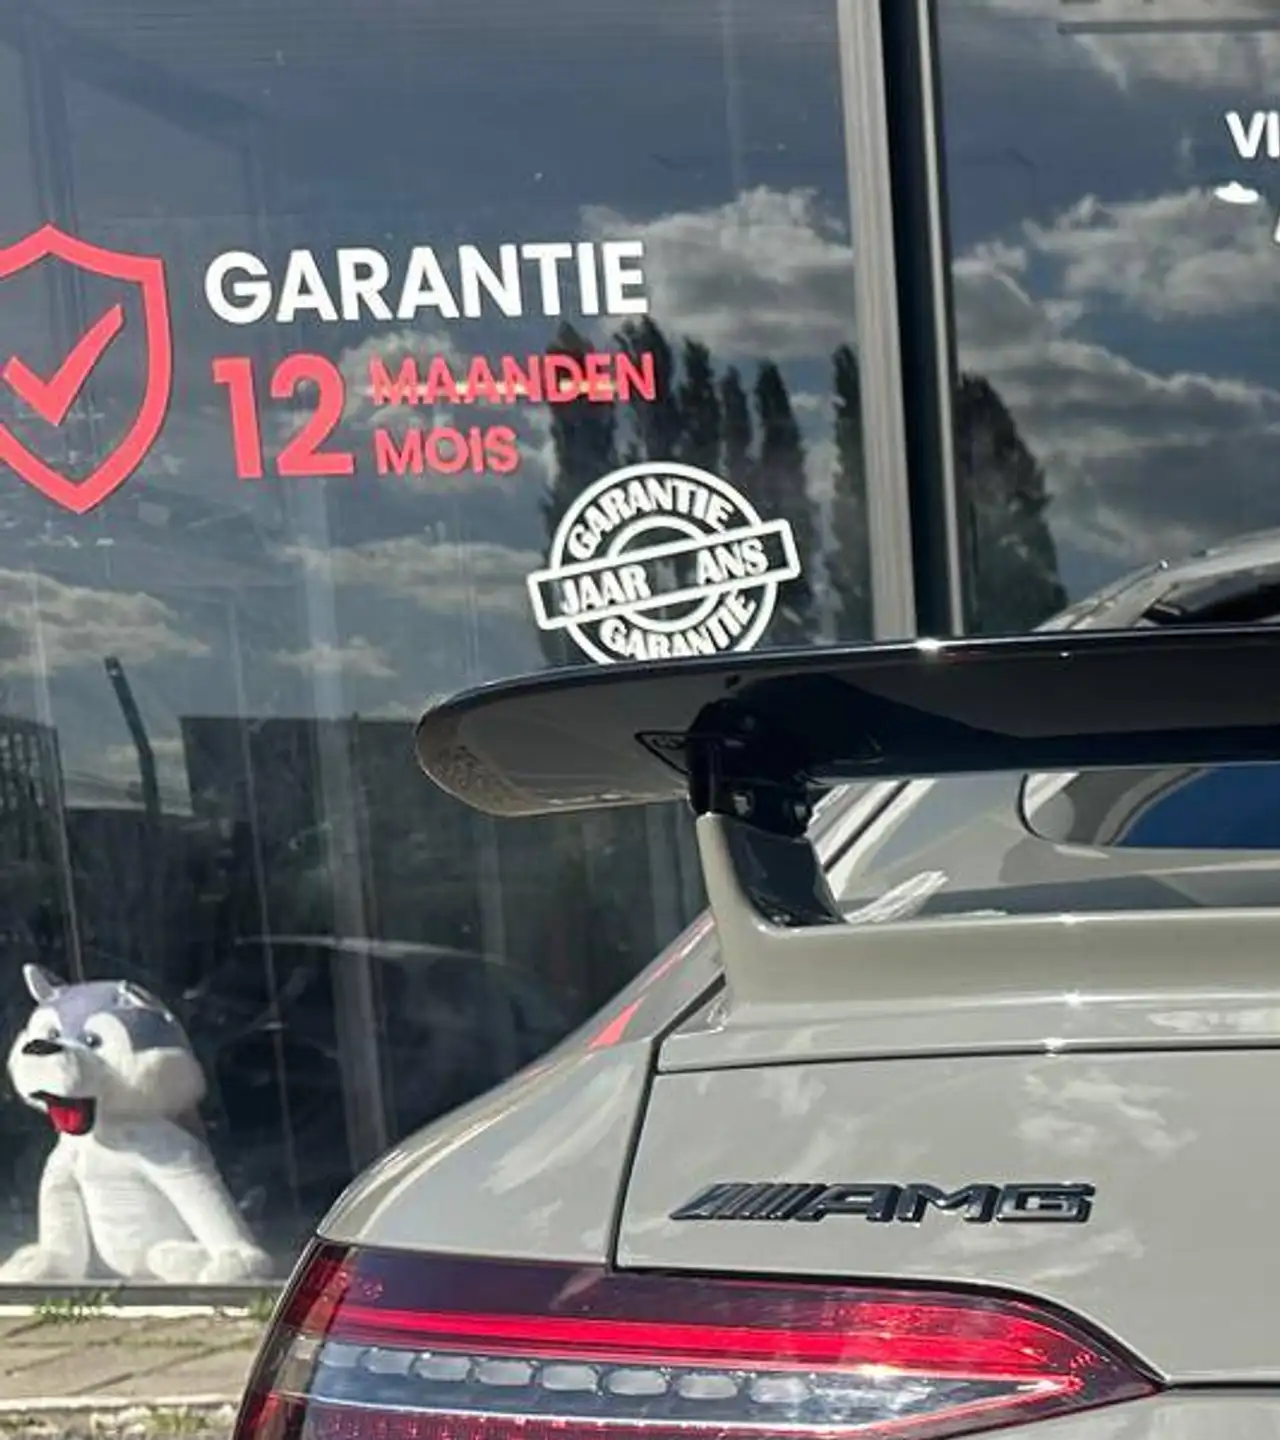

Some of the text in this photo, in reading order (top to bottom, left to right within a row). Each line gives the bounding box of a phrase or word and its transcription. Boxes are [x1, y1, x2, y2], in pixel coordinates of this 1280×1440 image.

[204, 241, 648, 325] GARANTIE
[213, 352, 656, 479] 12 MAANDEN
[374, 427, 519, 475] MOIS
[567, 477, 735, 559] GARANTIE
[560, 538, 769, 615] JAAR ANS
[598, 591, 757, 661] GARANTIE
[806, 1183, 1095, 1222] AMG
